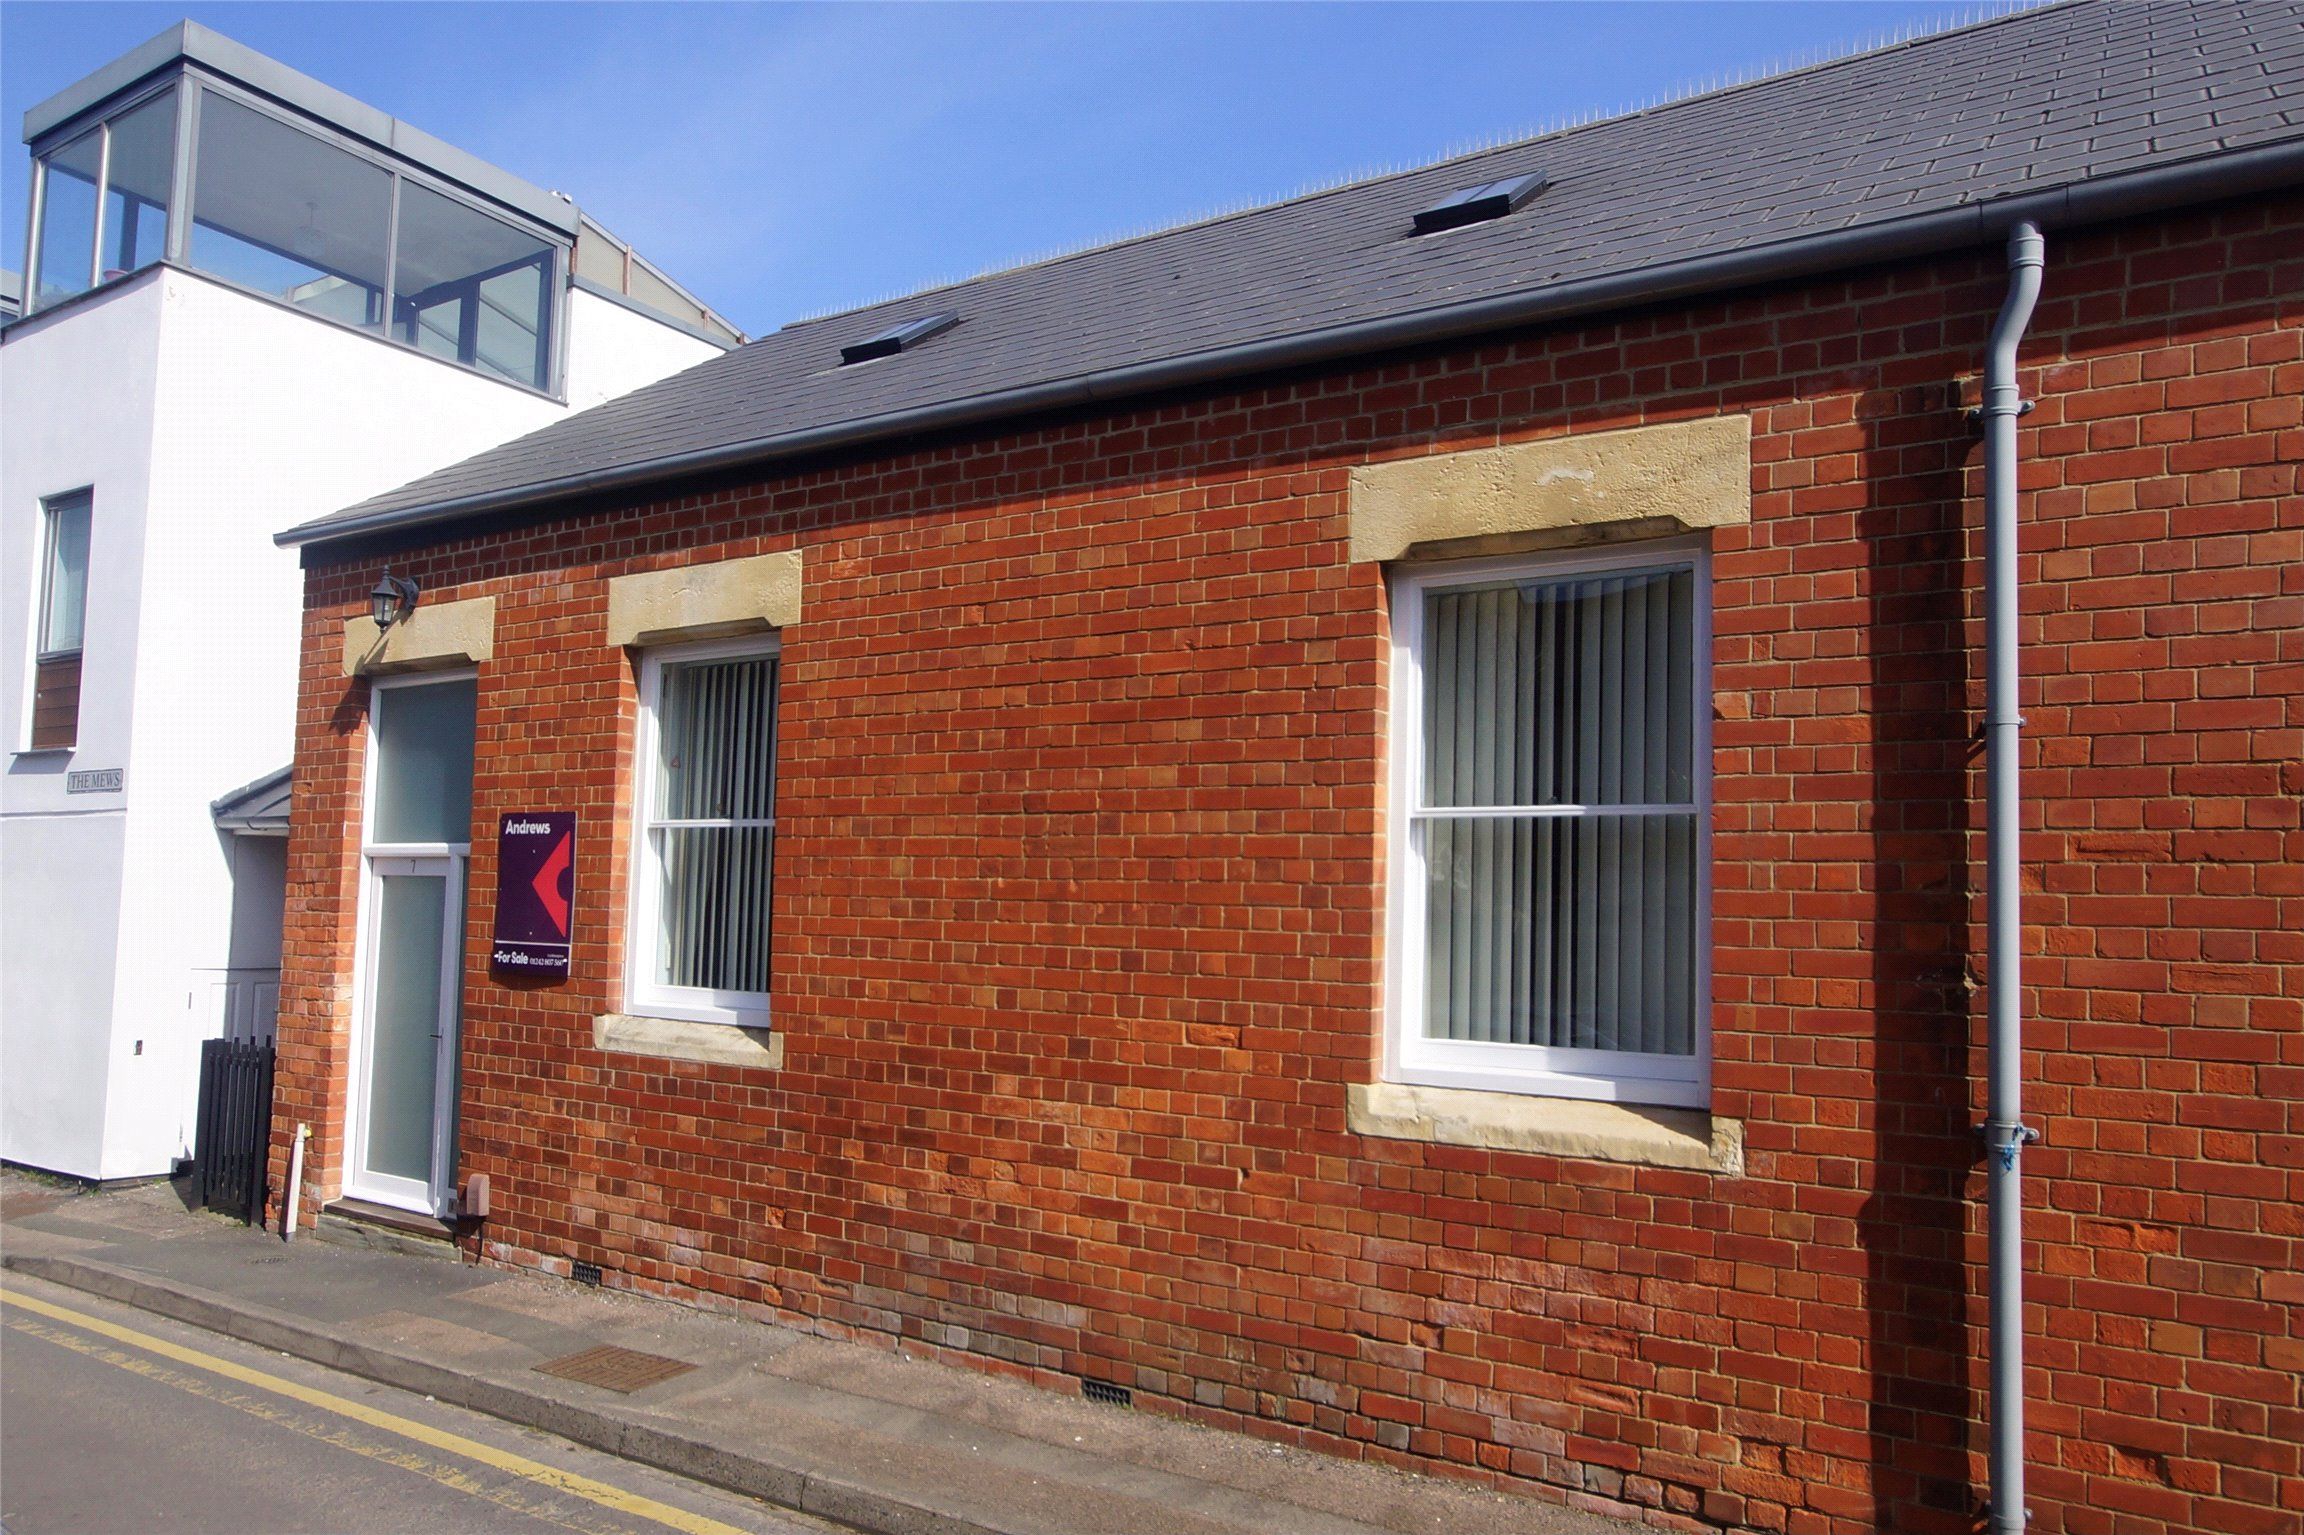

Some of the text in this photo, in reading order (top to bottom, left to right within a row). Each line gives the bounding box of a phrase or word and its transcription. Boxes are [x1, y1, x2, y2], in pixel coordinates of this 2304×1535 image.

[71, 772, 120, 789] THE MEWS
[505, 819, 551, 834] Andrews
[410, 859, 416, 873] 7
[498, 950, 511, 963] For
[511, 951, 529, 965] Sale
